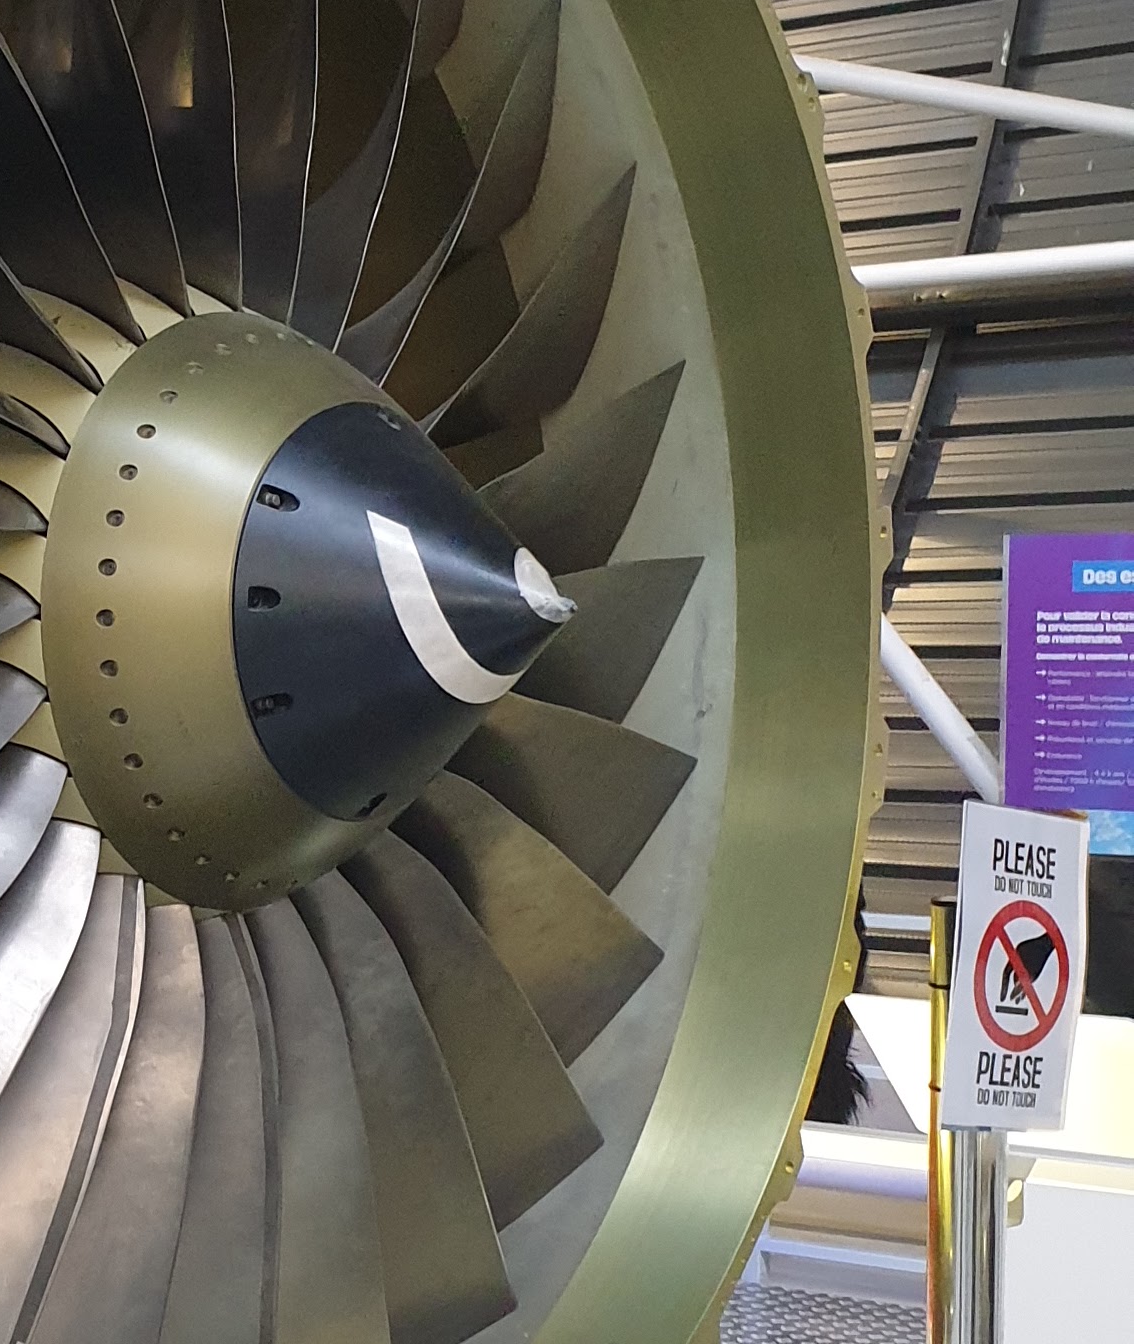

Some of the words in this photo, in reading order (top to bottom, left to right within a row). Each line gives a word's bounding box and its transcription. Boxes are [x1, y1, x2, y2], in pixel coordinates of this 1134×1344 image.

[1082, 568, 1117, 585] Des
[993, 838, 1056, 881] PLEASE
[994, 875, 1007, 892] DO
[1008, 877, 1024, 895] NOT
[1027, 878, 1053, 899] TOUCH
[976, 1051, 1043, 1089] PLEASE
[977, 1088, 990, 1105] DO
[992, 1089, 1009, 1107] NOT
[1012, 1090, 1036, 1108] TOUCH
